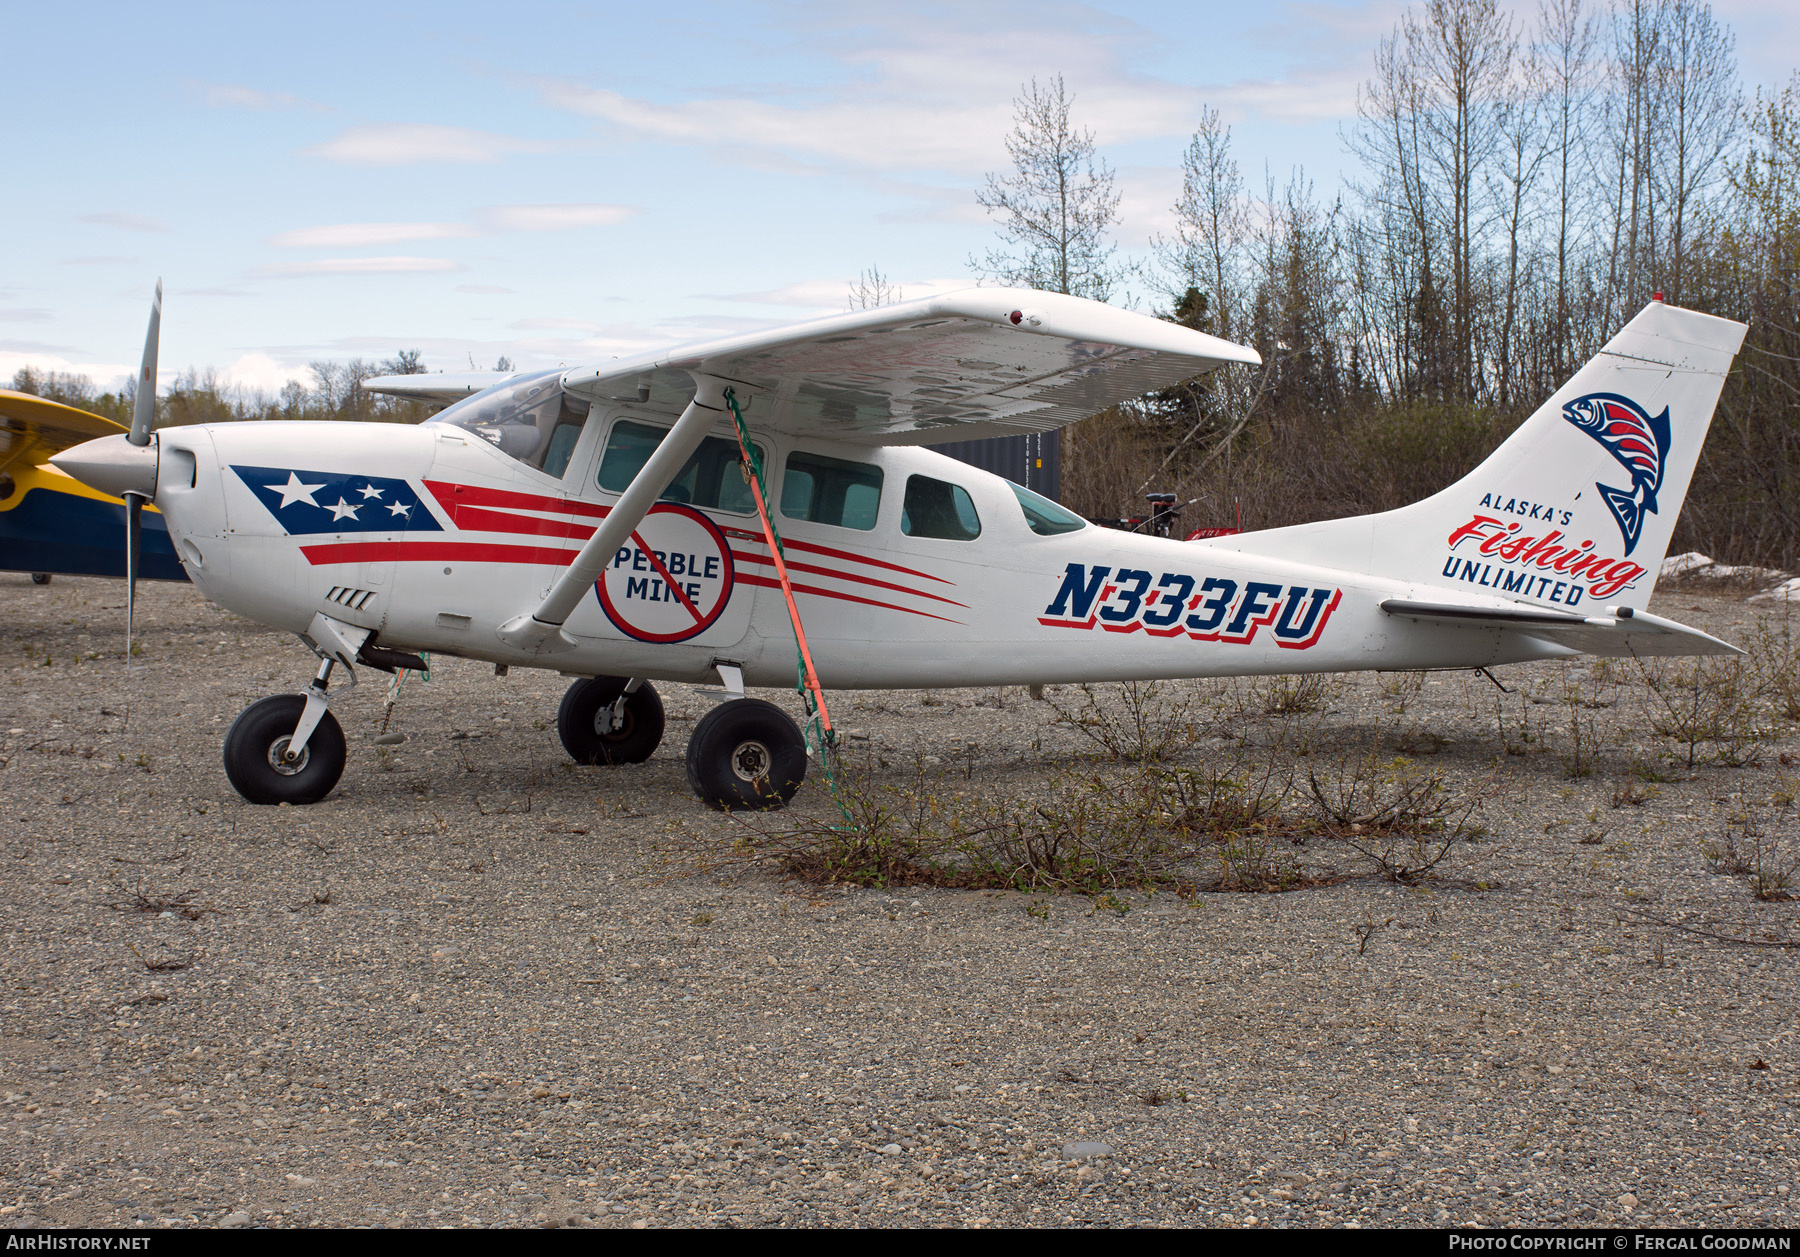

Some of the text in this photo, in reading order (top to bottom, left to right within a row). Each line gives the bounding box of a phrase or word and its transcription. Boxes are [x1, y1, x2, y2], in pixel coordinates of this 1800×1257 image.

[1479, 493, 1573, 526] ALASKA'S
[613, 546, 720, 579] PEBBLE
[1448, 514, 1648, 600] Fishing
[626, 576, 701, 605] MINE
[1442, 556, 1584, 606] UNLIMITED
[1038, 563, 1342, 649] N333FU
